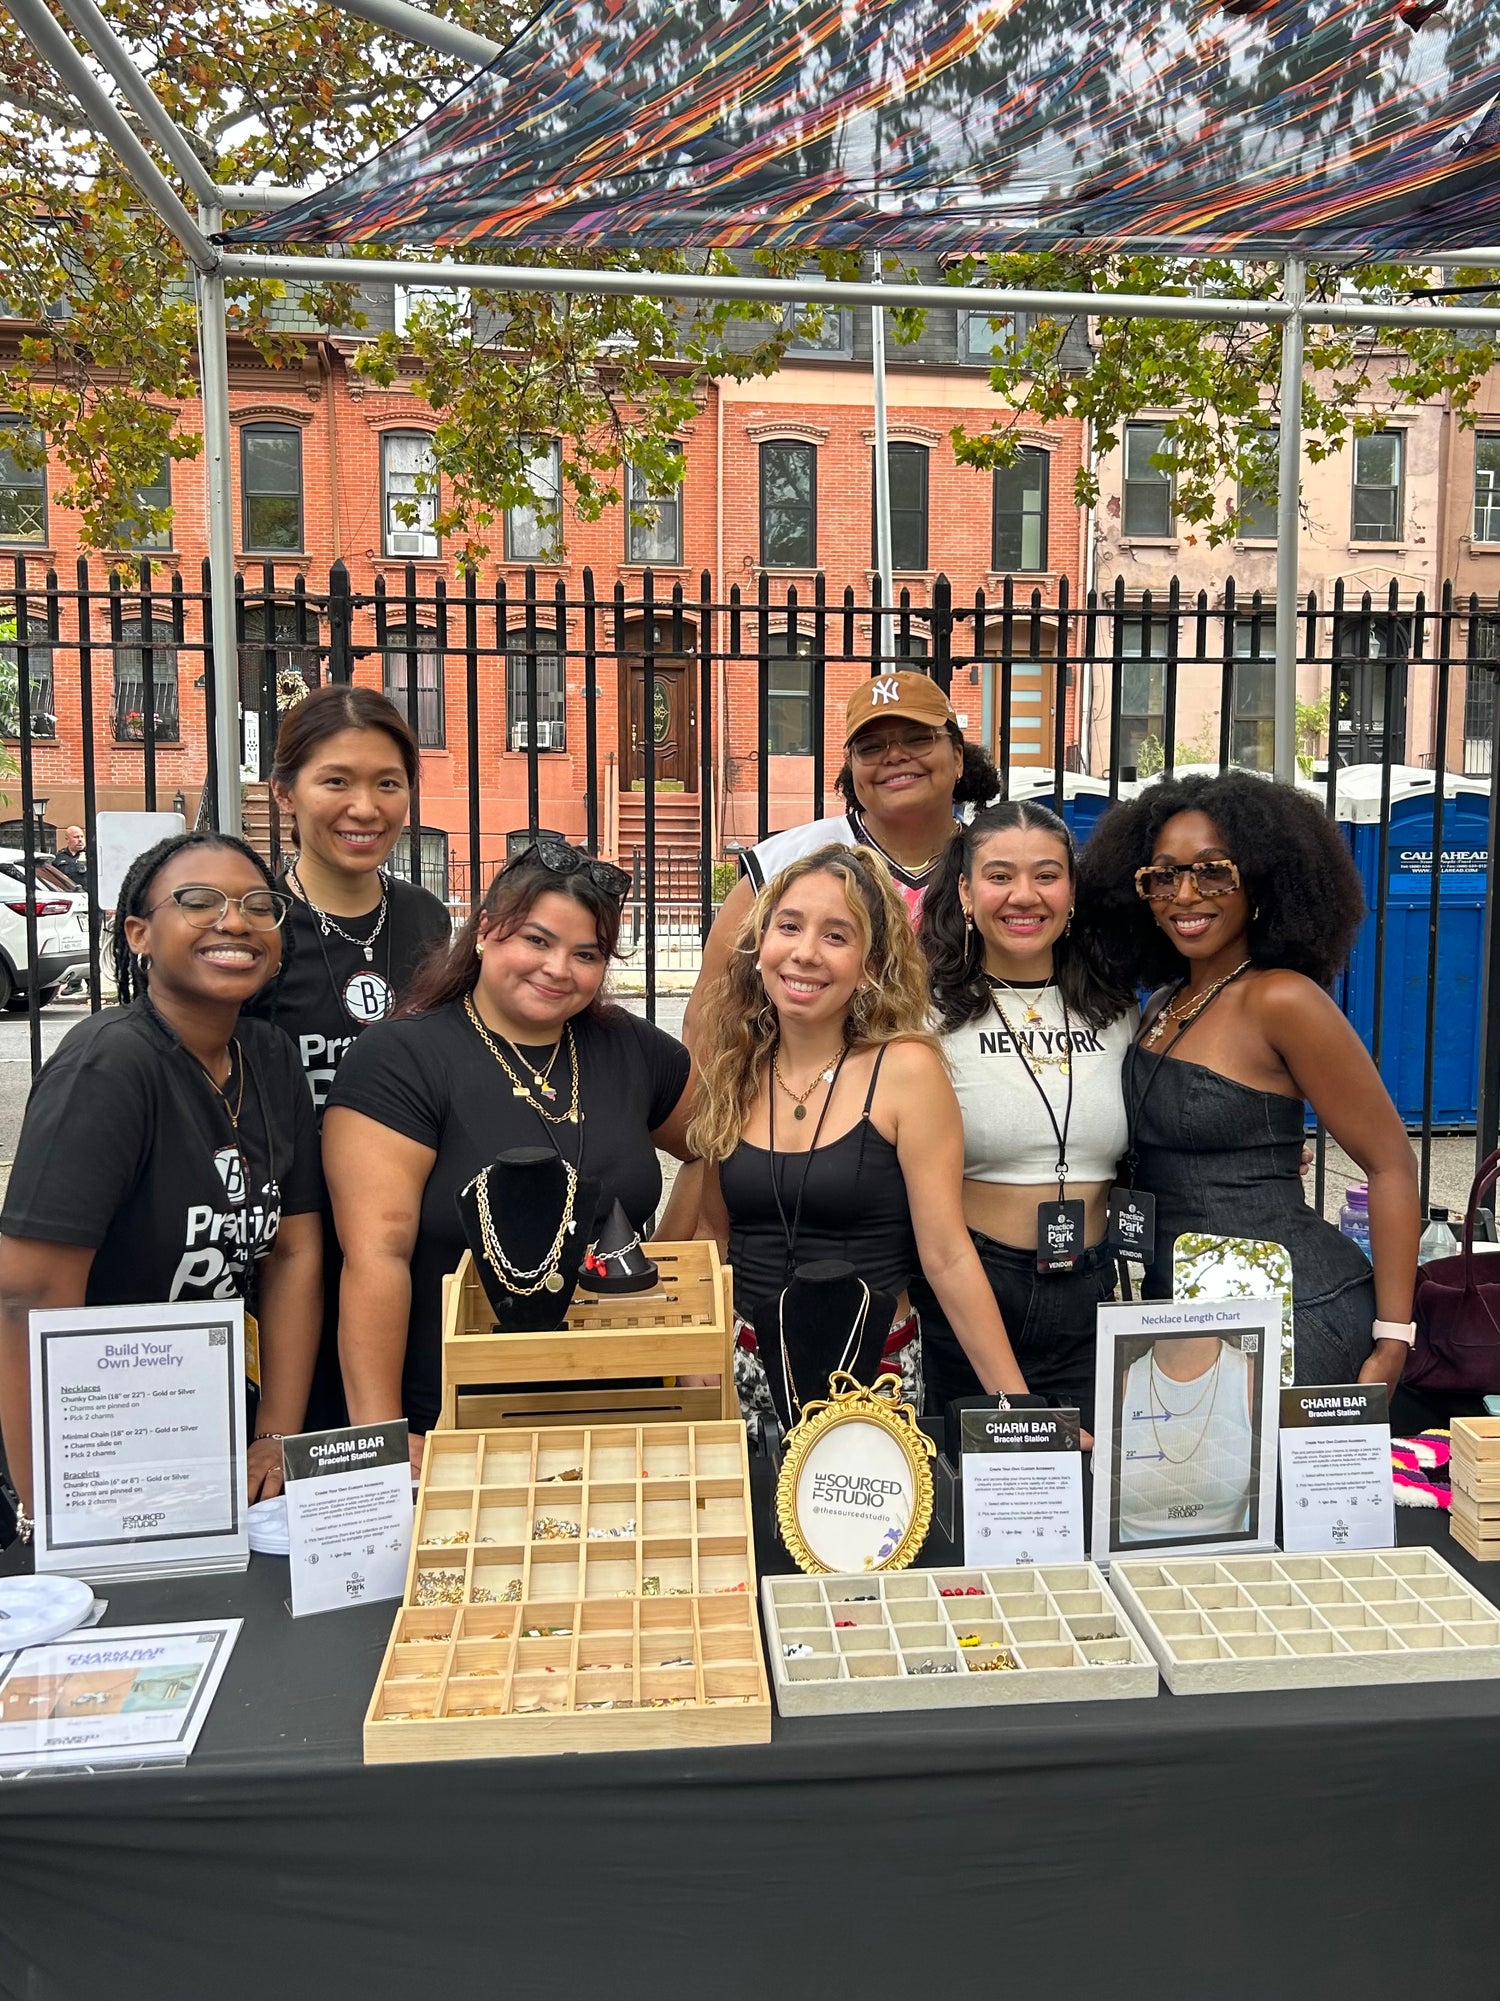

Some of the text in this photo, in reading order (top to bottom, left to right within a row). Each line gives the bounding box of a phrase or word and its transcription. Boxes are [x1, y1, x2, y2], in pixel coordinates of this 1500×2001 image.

[361, 981, 379, 1015] B
[979, 1030, 1106, 1055] NEW YORK
[1119, 1219, 1144, 1234] Park
[1048, 1231, 1074, 1243] Park
[1119, 1249, 1143, 1259] VENDOR
[1049, 1261, 1073, 1269] VENDOR
[1142, 1312, 1240, 1325] Necklace Length Chart
[105, 1343, 172, 1356] Build Your
[97, 1354, 183, 1369] Own Jewelry
[61, 1385, 100, 1393] Necklaces
[1300, 1397, 1367, 1409] CHARM BAR
[1308, 1409, 1360, 1418] Bracelet Station
[986, 1422, 1057, 1434] CHARM BAR
[1024, 1435, 1049, 1443] Station
[309, 1436, 384, 1458] CHARM BAR
[318, 1451, 377, 1466] Bracelet Station
[64, 1470, 100, 1479] Bracelets
[64, 1481, 89, 1489] Chunky
[813, 1473, 826, 1500] THE
[826, 1473, 902, 1496] SOURCED
[110, 1487, 132, 1495] pinned
[824, 1488, 885, 1508] STUDIO
[128, 1513, 165, 1522] SOURCED
[813, 1506, 890, 1522] @thesourcedstudio
[128, 1521, 158, 1529] STUDIO
[346, 1583, 365, 1592] Park
